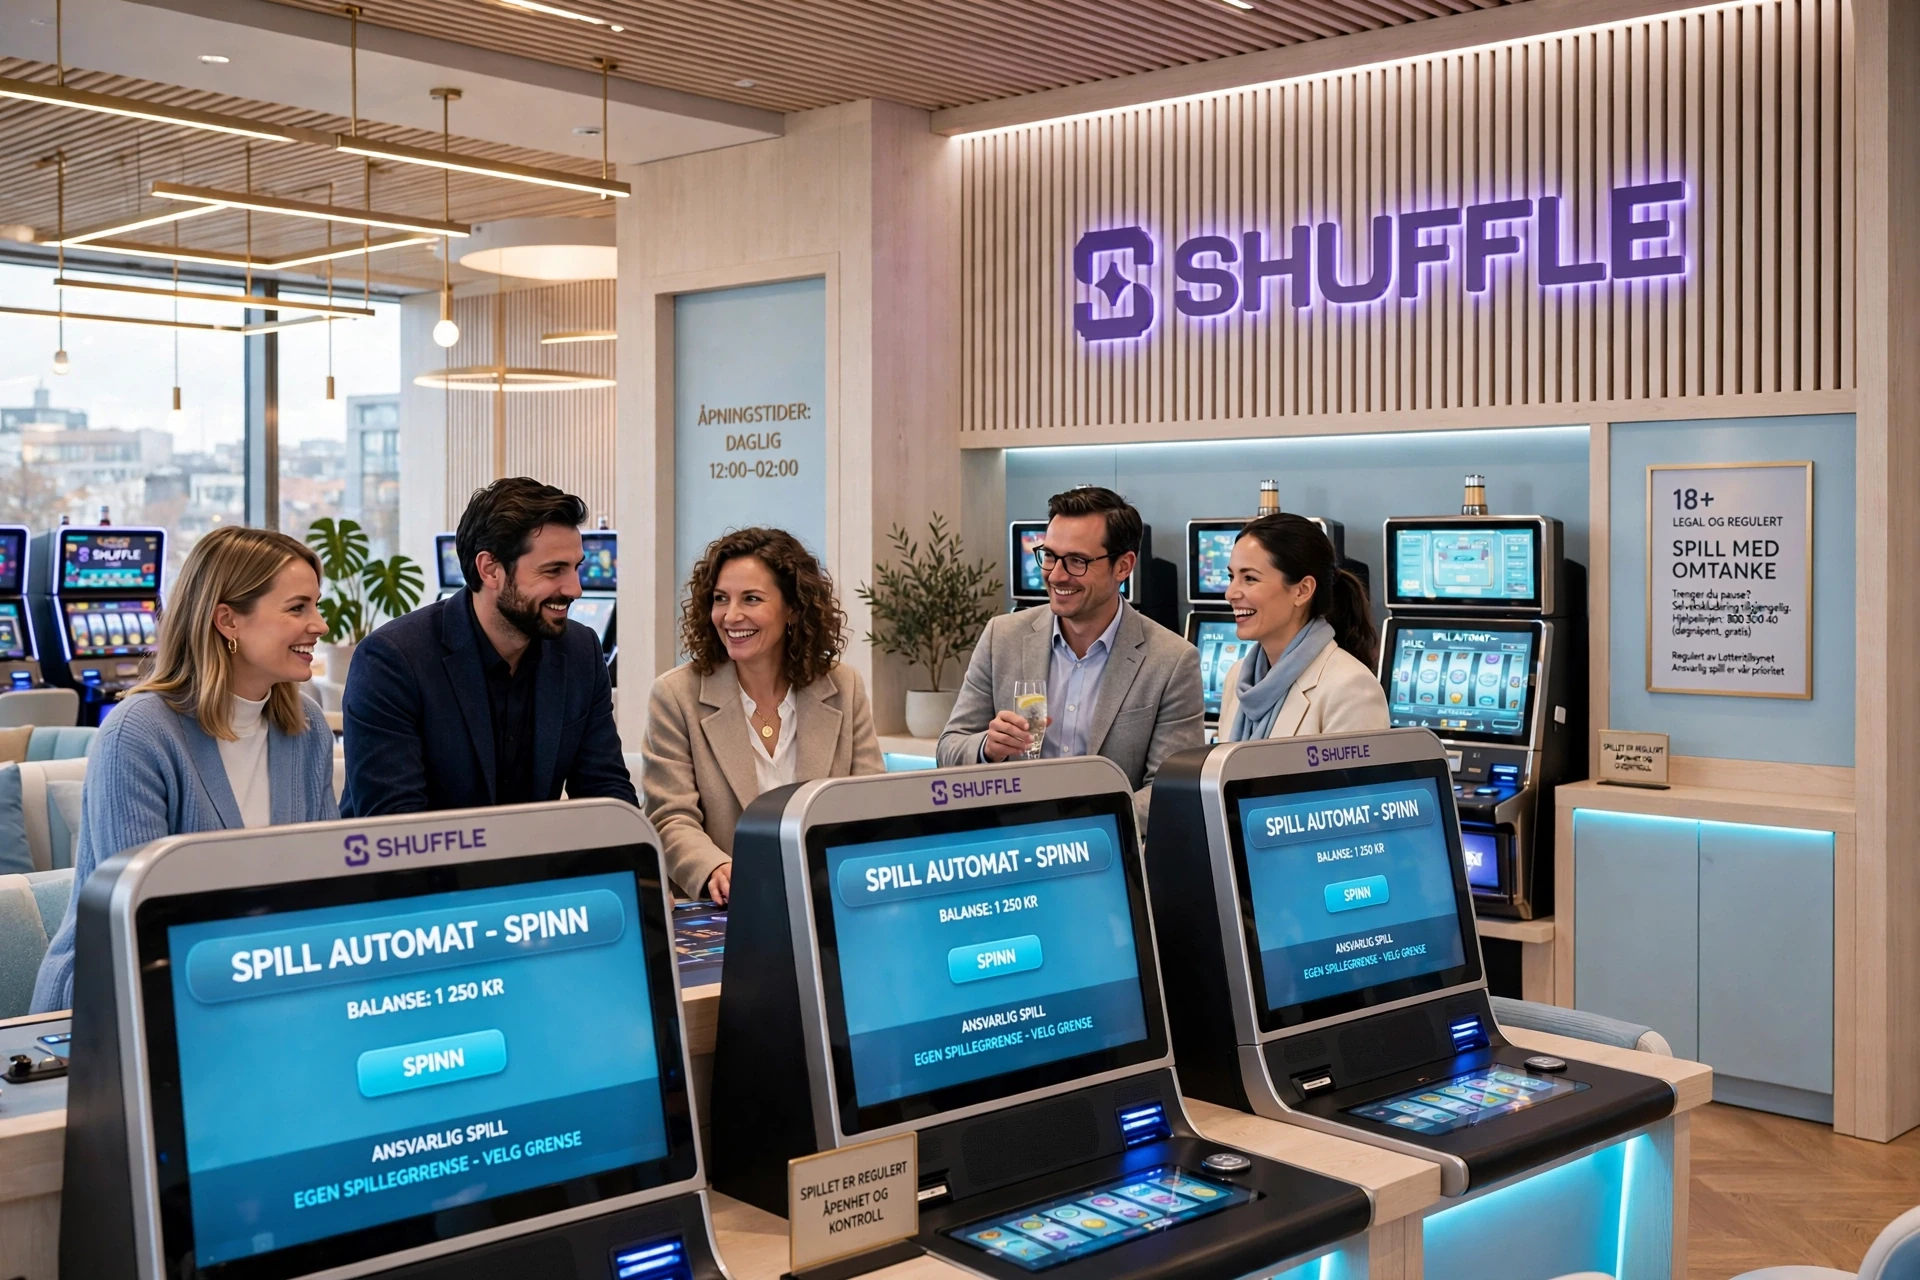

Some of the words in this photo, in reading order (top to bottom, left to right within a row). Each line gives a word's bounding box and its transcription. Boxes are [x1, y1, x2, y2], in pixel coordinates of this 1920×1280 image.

[1174, 180, 1685, 319] SHUFFLE
[698, 403, 811, 426] ÅPNINGSTIDER:
[726, 432, 782, 451] DAGLIG
[1673, 488, 1714, 510] 18+
[1672, 517, 1705, 527] LEGAL
[1708, 517, 1725, 527] OG
[1727, 516, 1783, 527] REGULERT
[1672, 540, 1726, 557] SPILL
[1733, 540, 1779, 557] MED
[1672, 562, 1776, 580] OMTANKE
[1706, 589, 1719, 600] du
[1720, 590, 1752, 601] pause?
[1707, 653, 1717, 661] av
[1321, 744, 1371, 762] SHUFFLE
[952, 777, 1022, 799] SHUFFLE
[1265, 814, 1305, 837] SPILL
[1307, 805, 1370, 831] AUTOMAT
[1381, 799, 1419, 821] SPINN
[376, 828, 487, 858] SHUFFLE
[1316, 847, 1353, 863] BALANSE:
[1354, 846, 1359, 857] 1
[1360, 844, 1374, 857] 250
[1374, 842, 1385, 854] KR
[865, 862, 922, 892] SPILL
[926, 850, 1020, 884] AUTOMAT
[1035, 841, 1090, 868] SPINN
[1343, 886, 1371, 902] SPINN
[939, 903, 993, 923] BALANSE:
[994, 900, 1001, 914] 1
[1002, 897, 1022, 913] 250
[1024, 895, 1038, 909] KR
[231, 943, 323, 983] SPILL
[328, 920, 478, 969] AUTOMAT
[504, 906, 589, 944] SPINN
[1374, 933, 1393, 946] SPILL
[976, 948, 1017, 970] SPINN
[347, 990, 432, 1019] BALANSE:
[435, 987, 444, 1004] 1
[448, 983, 479, 1002] 250
[481, 978, 505, 996] KR
[962, 1010, 1018, 1034] ANSVARLIG
[1019, 1005, 1046, 1022] SPILL
[914, 1048, 943, 1067] EGEN
[1030, 1024, 1055, 1040] VELG
[1057, 1016, 1093, 1035] GRENSE
[402, 1047, 465, 1078] SPINN
[371, 1128, 463, 1163] ANSVARLIG
[465, 1119, 508, 1142] SPILL
[293, 1184, 340, 1209] EGEN
[343, 1155, 470, 1198] SPILLEGRRENSE
[482, 1144, 522, 1166] VELG
[525, 1130, 582, 1157] GRENSE
[800, 1179, 840, 1201] SPILLET
[842, 1175, 856, 1190] ER
[858, 1161, 908, 1186] REGULERT
[823, 1192, 870, 1217] ÅPENHET
[872, 1187, 888, 1203] OG
[828, 1208, 884, 1235] KONTROLL
